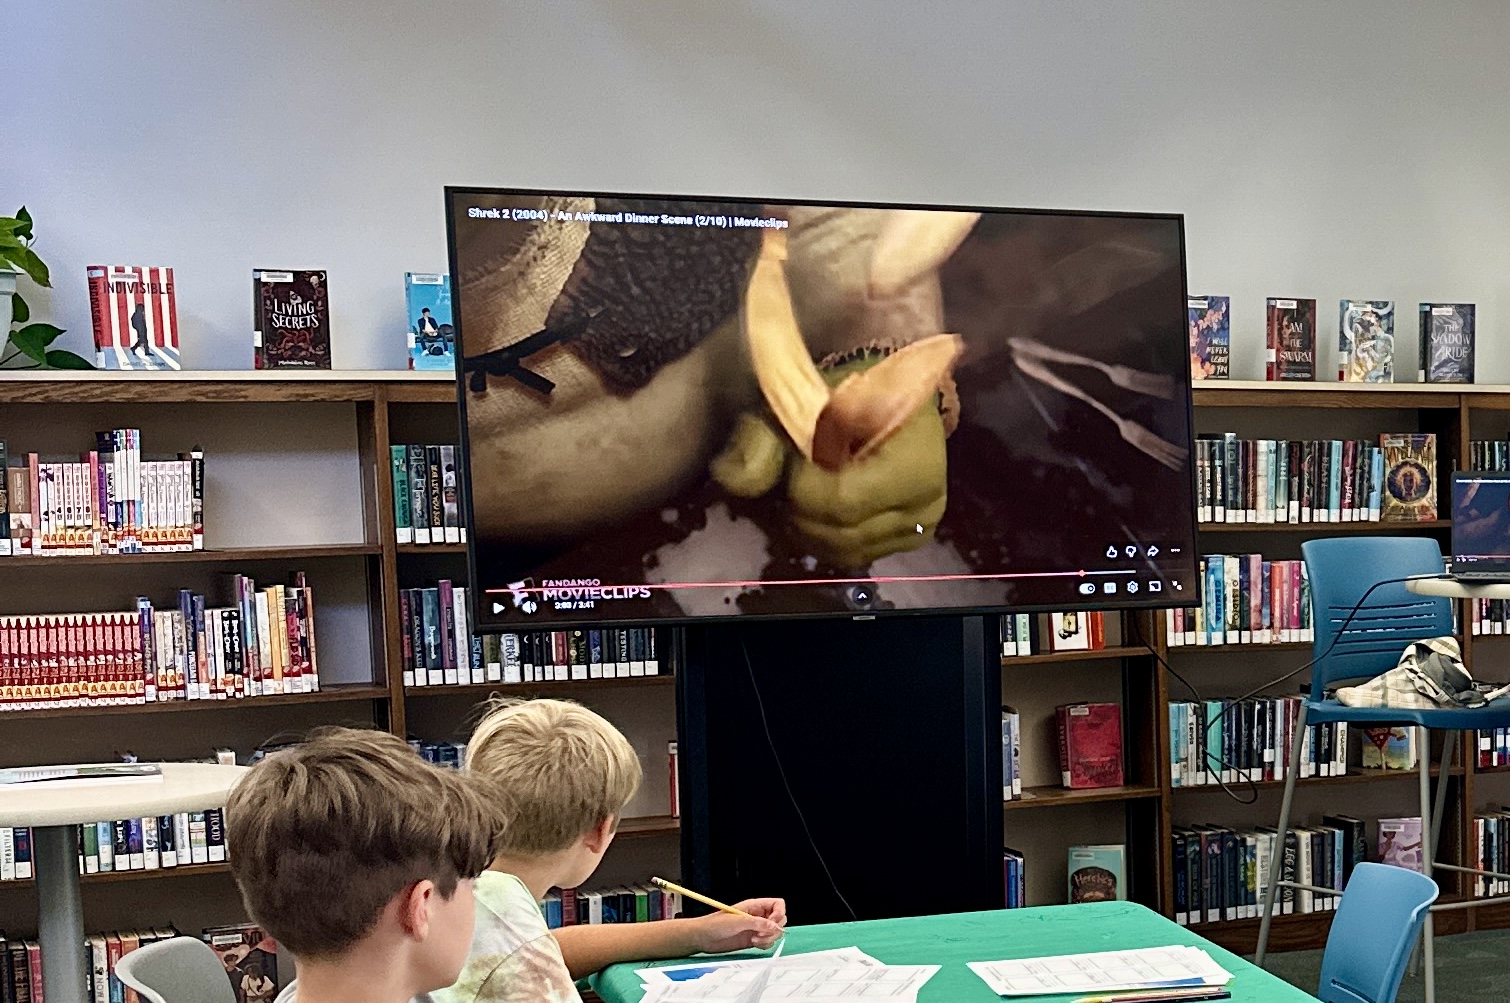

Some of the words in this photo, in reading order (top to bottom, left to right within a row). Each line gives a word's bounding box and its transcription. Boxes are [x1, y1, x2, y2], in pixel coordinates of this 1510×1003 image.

[468, 207, 500, 219] Shrek
[502, 208, 510, 219] 2
[512, 208, 548, 222] (2004)
[558, 211, 573, 221] An
[574, 211, 623, 223] Awkward
[625, 212, 659, 224] Dinner
[661, 214, 693, 225] Scene
[695, 215, 727, 229] (2/10)
[734, 217, 789, 230] Movieclips
[103, 282, 174, 295] INDIVISIBLE
[274, 298, 315, 315] LIVING
[271, 313, 320, 330] SECRETS
[1443, 324, 1459, 332] THE
[542, 579, 600, 587] FANDANGO
[542, 586, 651, 601] MOVIECLIPS
[1285, 847, 1295, 865] EGG
